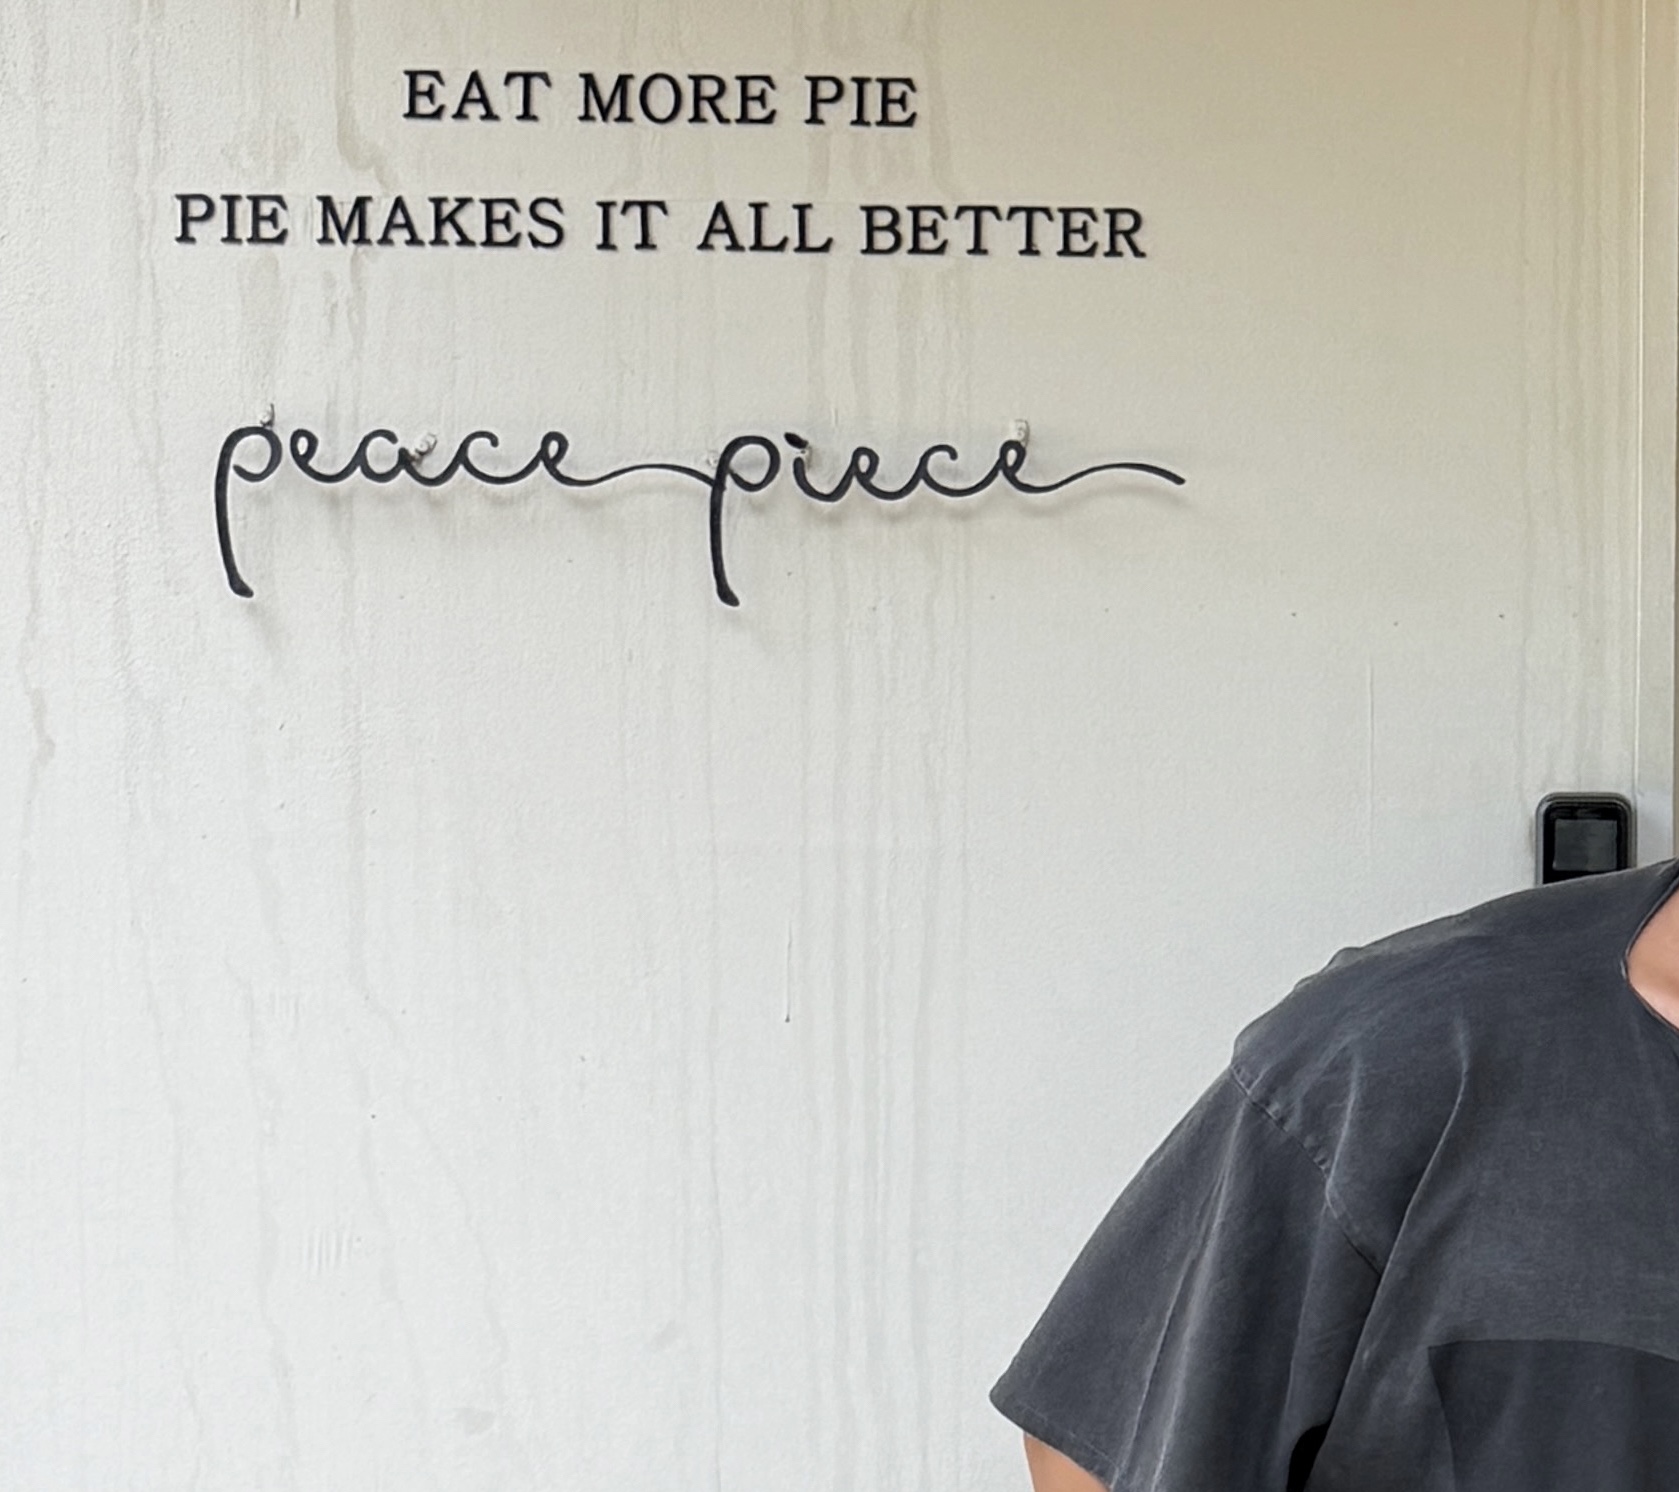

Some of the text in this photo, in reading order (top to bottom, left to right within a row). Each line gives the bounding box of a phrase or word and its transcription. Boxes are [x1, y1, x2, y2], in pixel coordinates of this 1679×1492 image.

[402, 69, 918, 128] EAT MORE PIE
[175, 193, 1147, 259] PIE MAKES IT ALL BETTER
[215, 420, 1186, 607] peace piece
